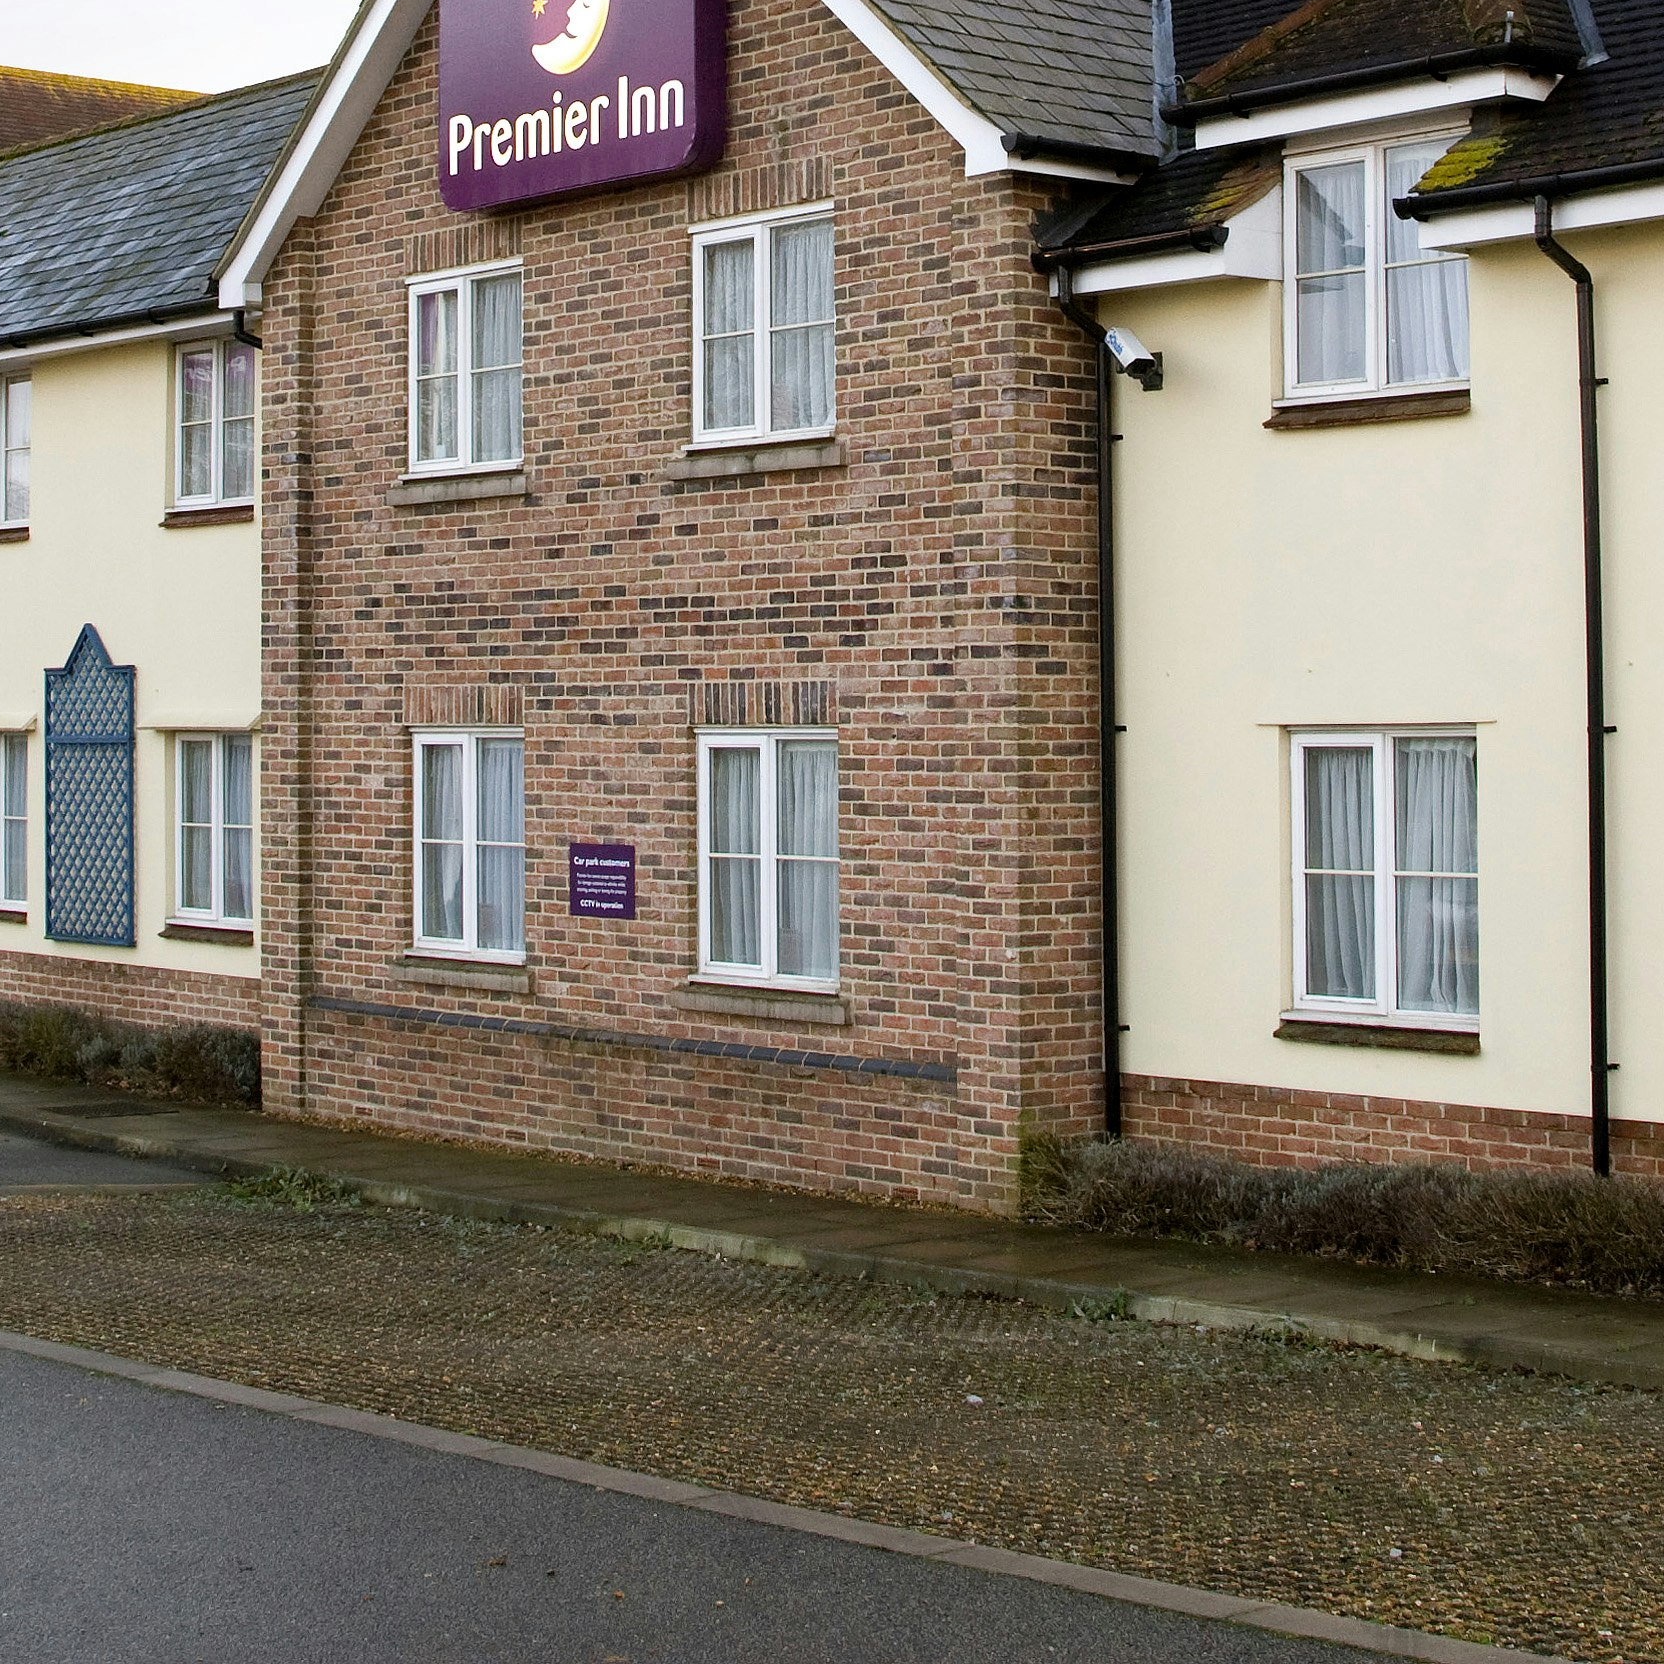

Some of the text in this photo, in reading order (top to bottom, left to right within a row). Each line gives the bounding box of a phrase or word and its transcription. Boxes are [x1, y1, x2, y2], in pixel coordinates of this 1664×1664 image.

[448, 75, 684, 176] Premier Inn
[573, 856, 630, 867] Car park customers
[580, 899, 595, 907] CCTV
[600, 902, 624, 910] operation
